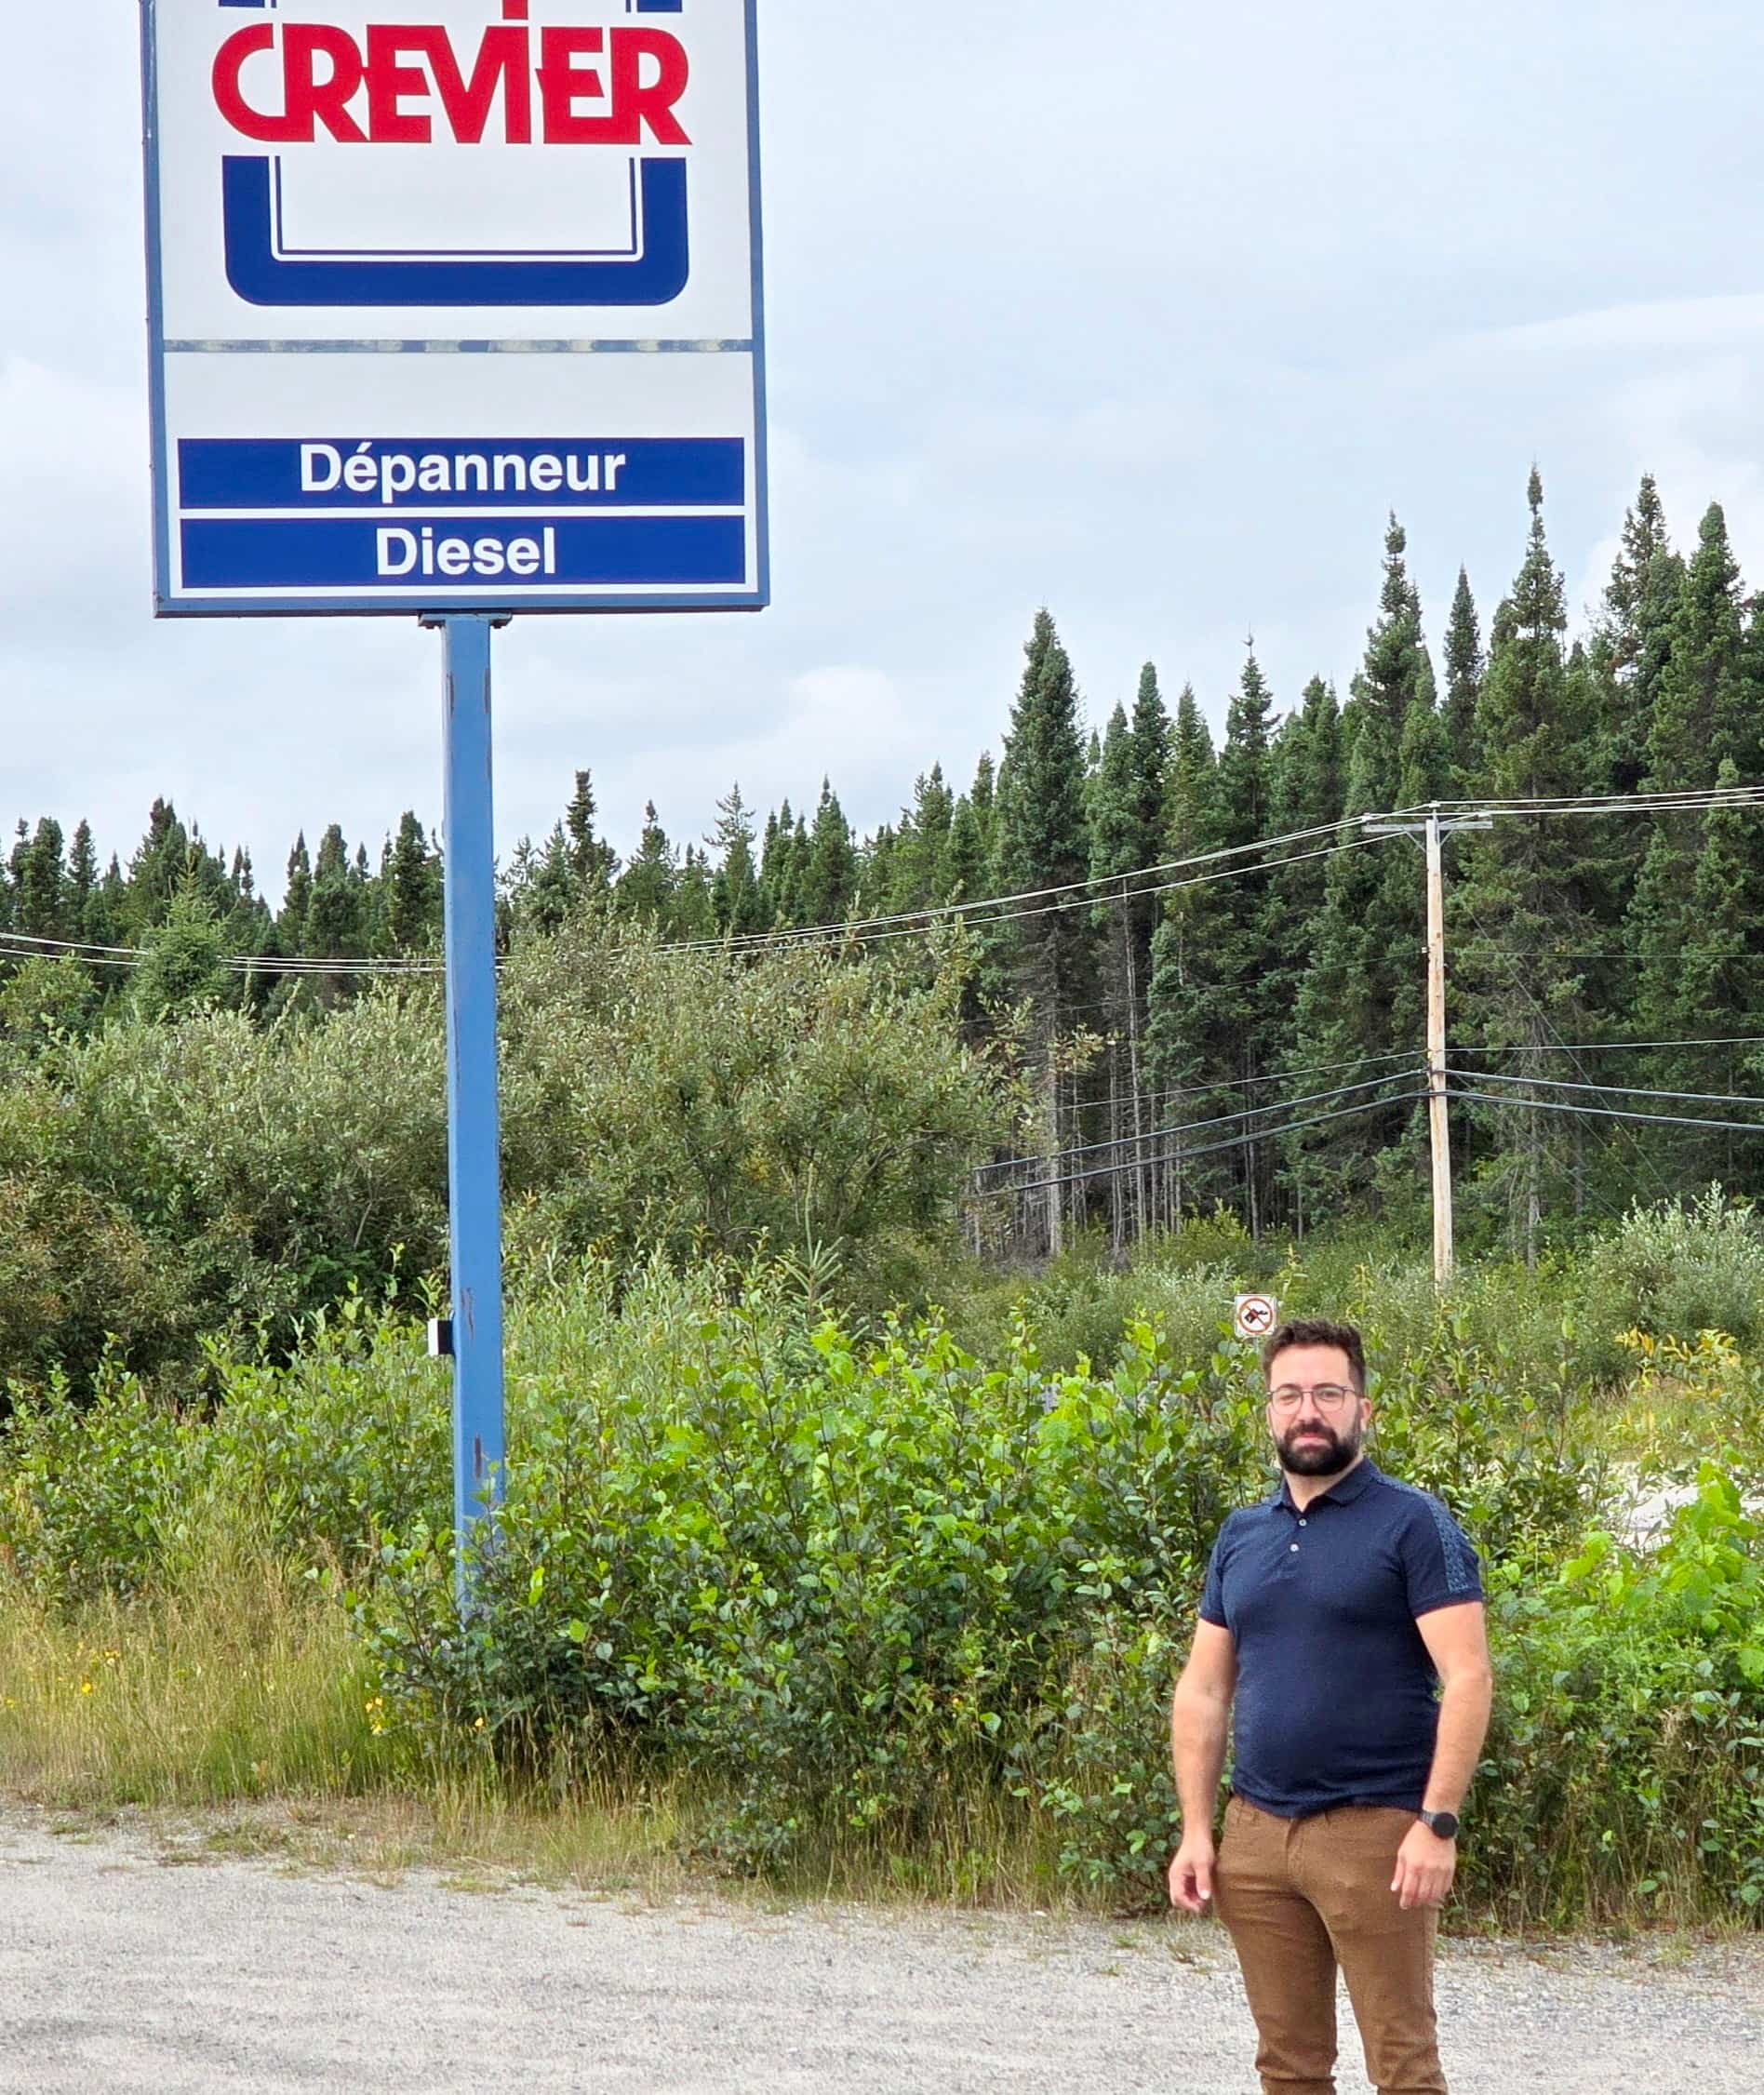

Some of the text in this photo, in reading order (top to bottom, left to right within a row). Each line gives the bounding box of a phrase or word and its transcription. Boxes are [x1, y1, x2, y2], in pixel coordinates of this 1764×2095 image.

[212, 20, 692, 146] CREVIER
[300, 441, 627, 504] Dépanneur
[376, 527, 555, 575] Diesel
